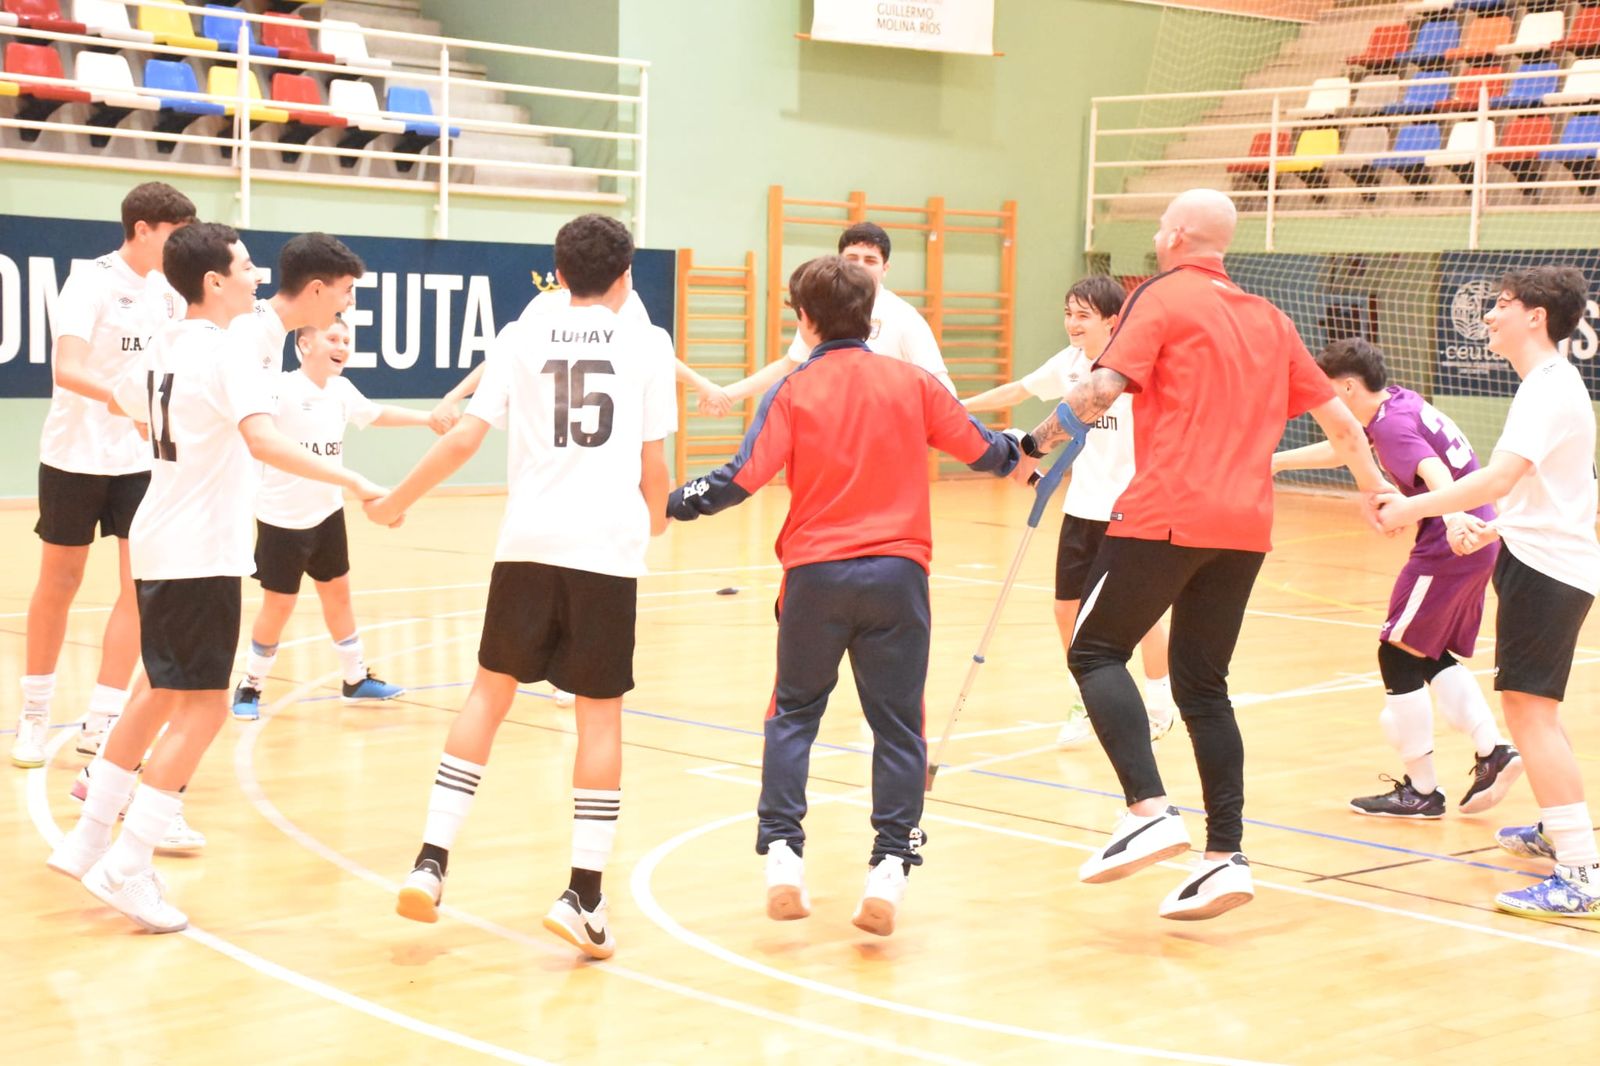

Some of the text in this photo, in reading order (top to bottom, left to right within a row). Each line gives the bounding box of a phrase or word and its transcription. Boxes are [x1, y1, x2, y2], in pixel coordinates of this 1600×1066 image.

[877, 2, 934, 20] GUILLERMO
[877, 17, 916, 33] MOLINA
[296, 271, 496, 369] EUTA
[551, 329, 614, 344] LUHAY
[540, 359, 616, 448] 15
